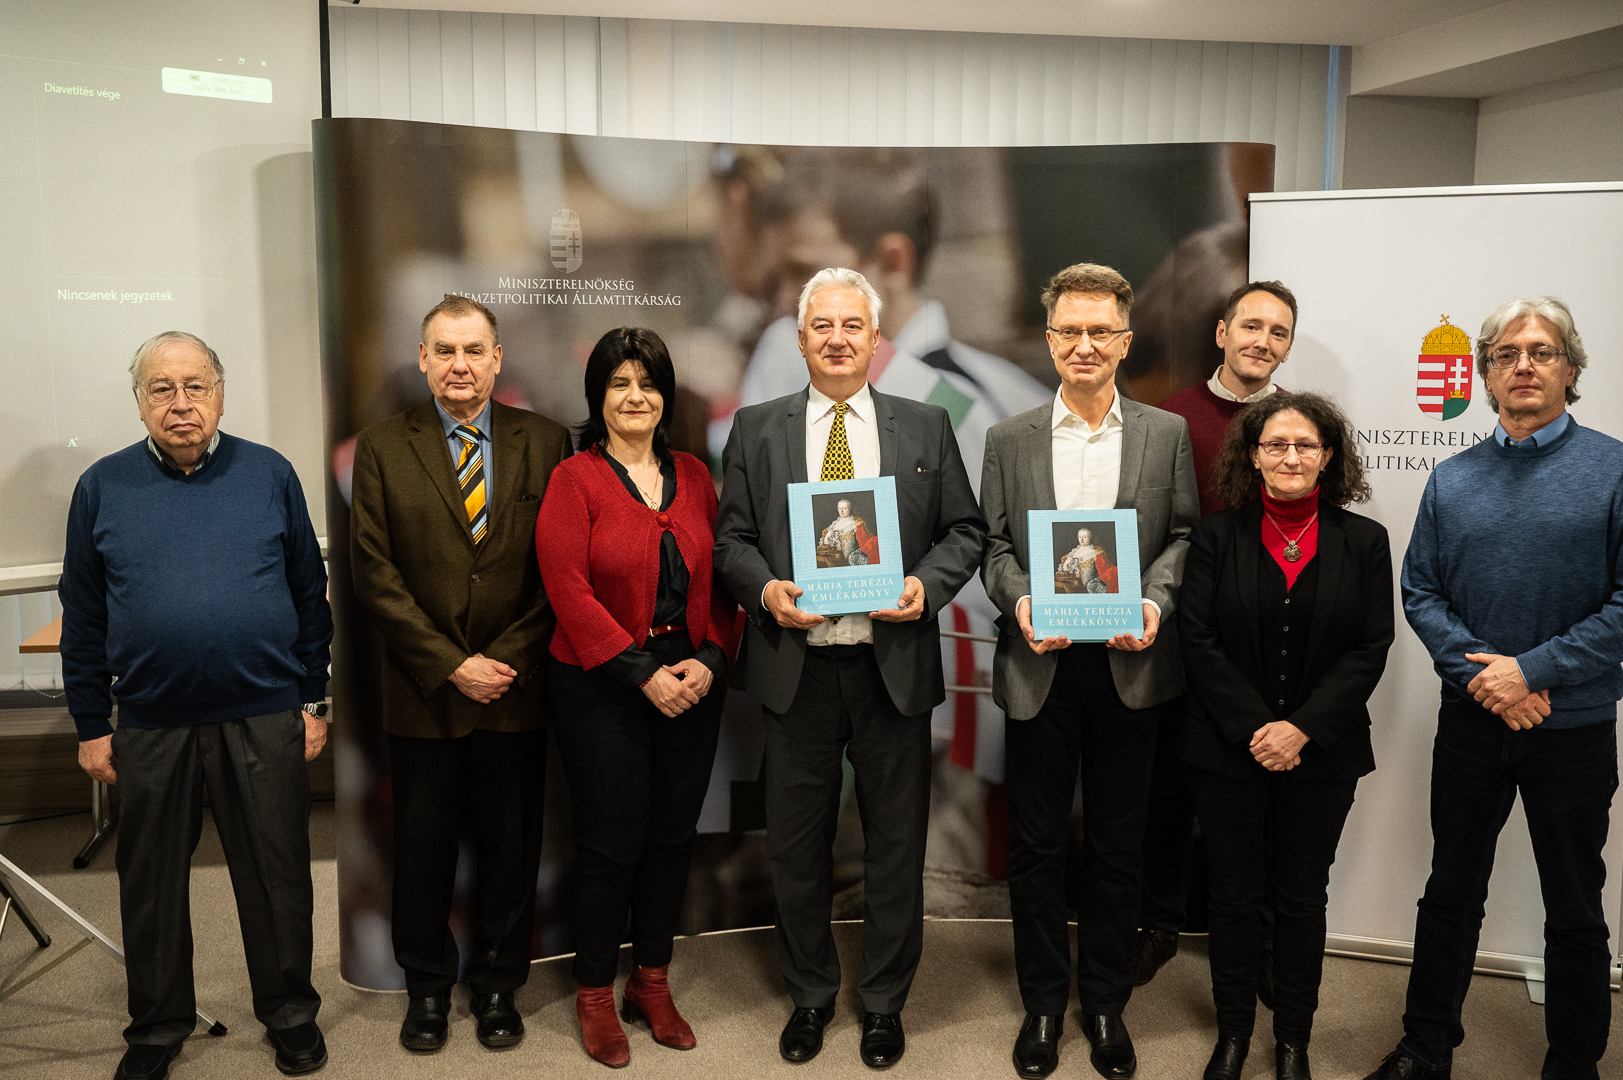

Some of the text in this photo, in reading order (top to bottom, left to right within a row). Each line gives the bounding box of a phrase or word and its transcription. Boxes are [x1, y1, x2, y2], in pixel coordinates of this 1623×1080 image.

[44, 82, 121, 101] Diavetítés vége
[498, 277, 634, 291] MINISZTERELNÖKSÉG
[57, 289, 176, 304] Nincsenek jegyzetek.
[572, 291, 681, 306] ÁLLAMTITKÁRSÁG
[807, 577, 894, 592] MÁRIA TERÉZIA
[812, 588, 890, 602] EMLÉKKÖNYV
[1044, 606, 1132, 616] MÁRIA TERÉZIA
[1049, 617, 1128, 627] EMLÉKKÖNYV
